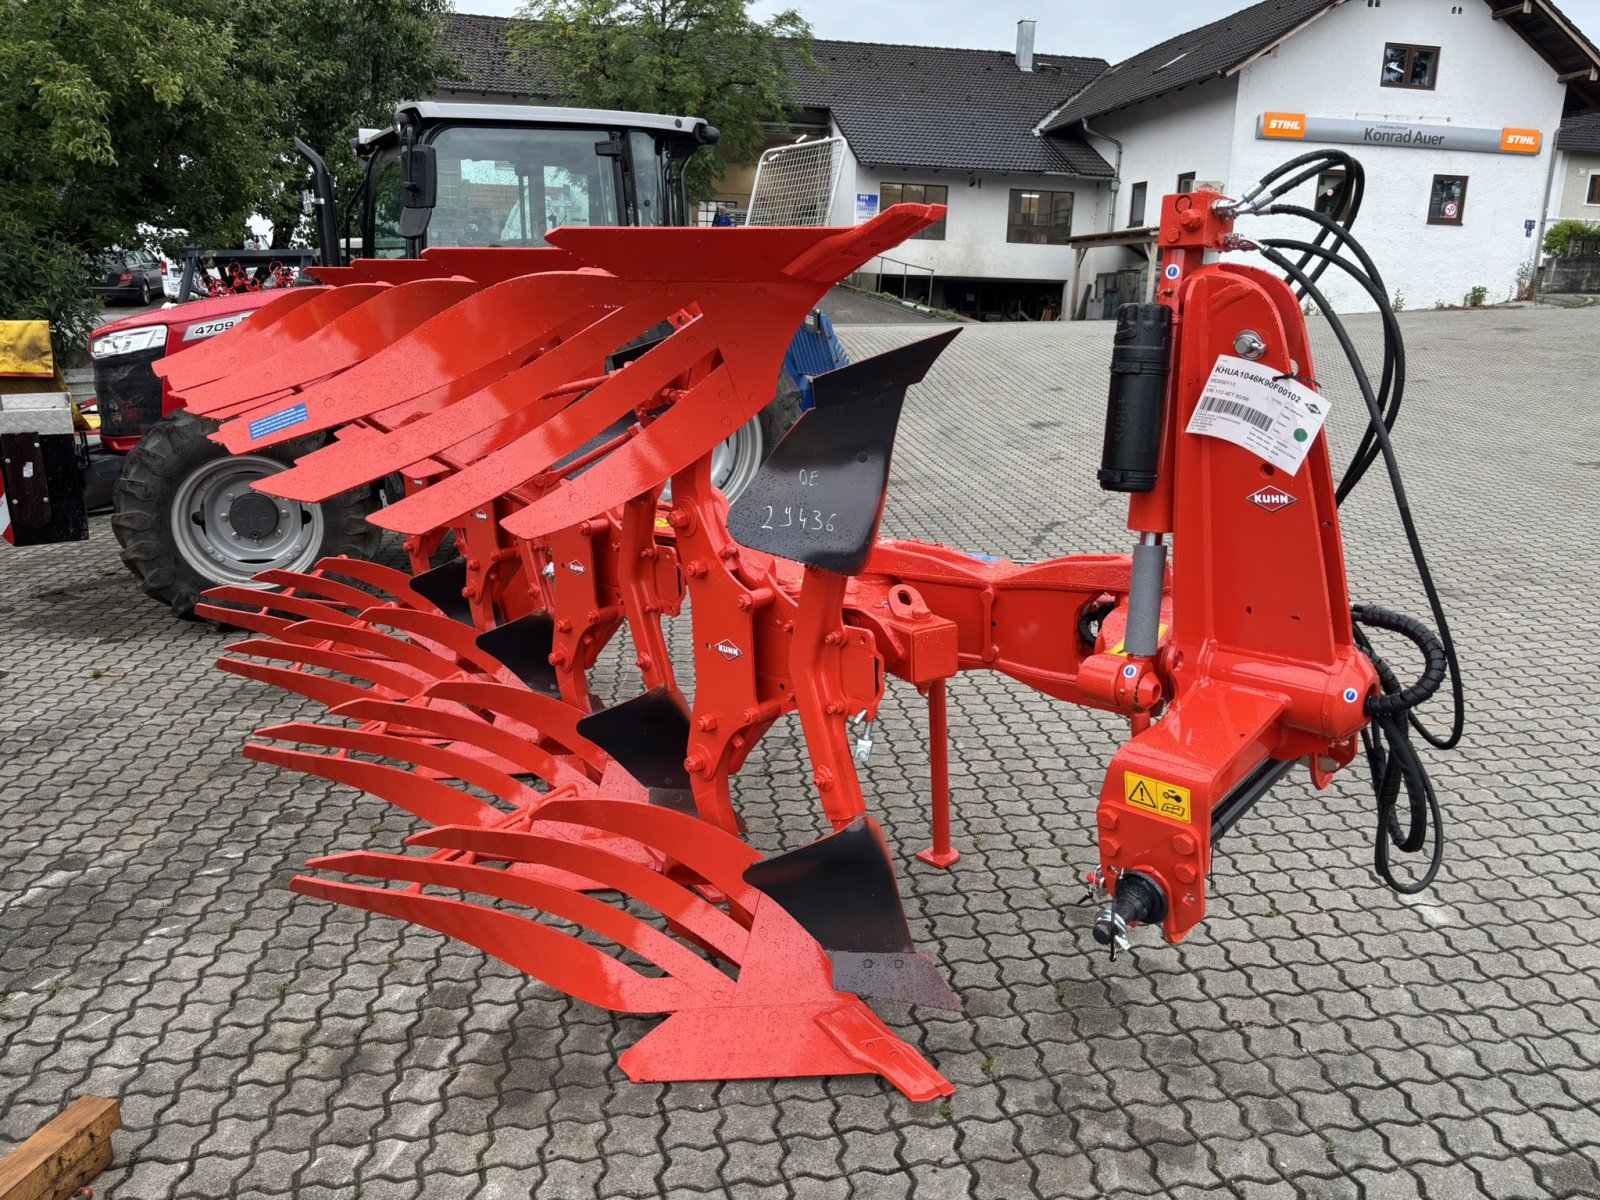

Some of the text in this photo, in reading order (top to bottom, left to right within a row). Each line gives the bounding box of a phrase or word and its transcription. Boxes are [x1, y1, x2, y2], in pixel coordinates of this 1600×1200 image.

[1268, 119, 1301, 130] STIHL
[1364, 127, 1445, 145] Konrad Auer
[1506, 135, 1536, 145] STIHL
[194, 321, 234, 335] 4709
[1214, 365, 1302, 404] KHUA1046K90F00102
[1254, 495, 1288, 504] KUHN
[761, 505, 837, 532] 29436
[718, 644, 739, 656] KUHN
